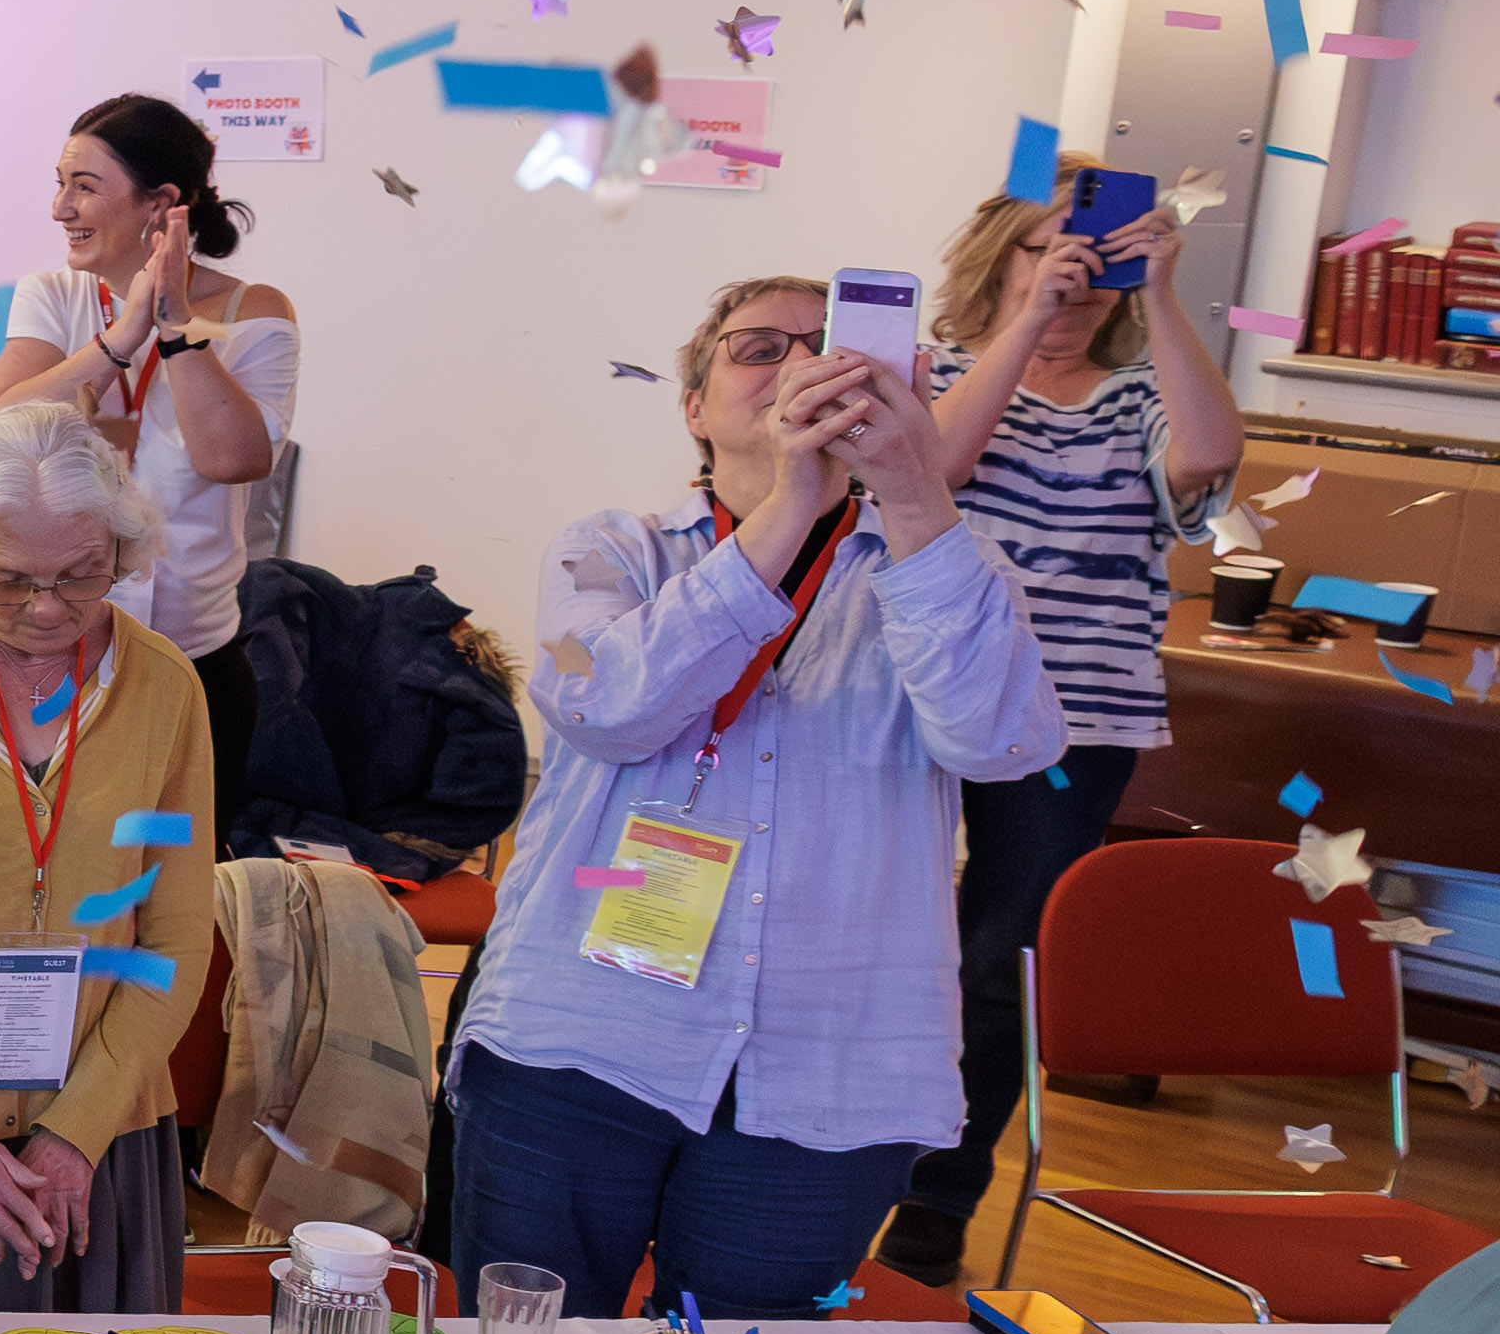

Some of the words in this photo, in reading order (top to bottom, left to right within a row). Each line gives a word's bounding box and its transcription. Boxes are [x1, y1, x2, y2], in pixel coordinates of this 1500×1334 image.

[207, 98, 252, 109] PHOTO
[254, 97, 301, 109] BOOTH
[221, 115, 251, 127] THIS
[254, 115, 287, 127] WAY
[43, 959, 67, 967] GUEST
